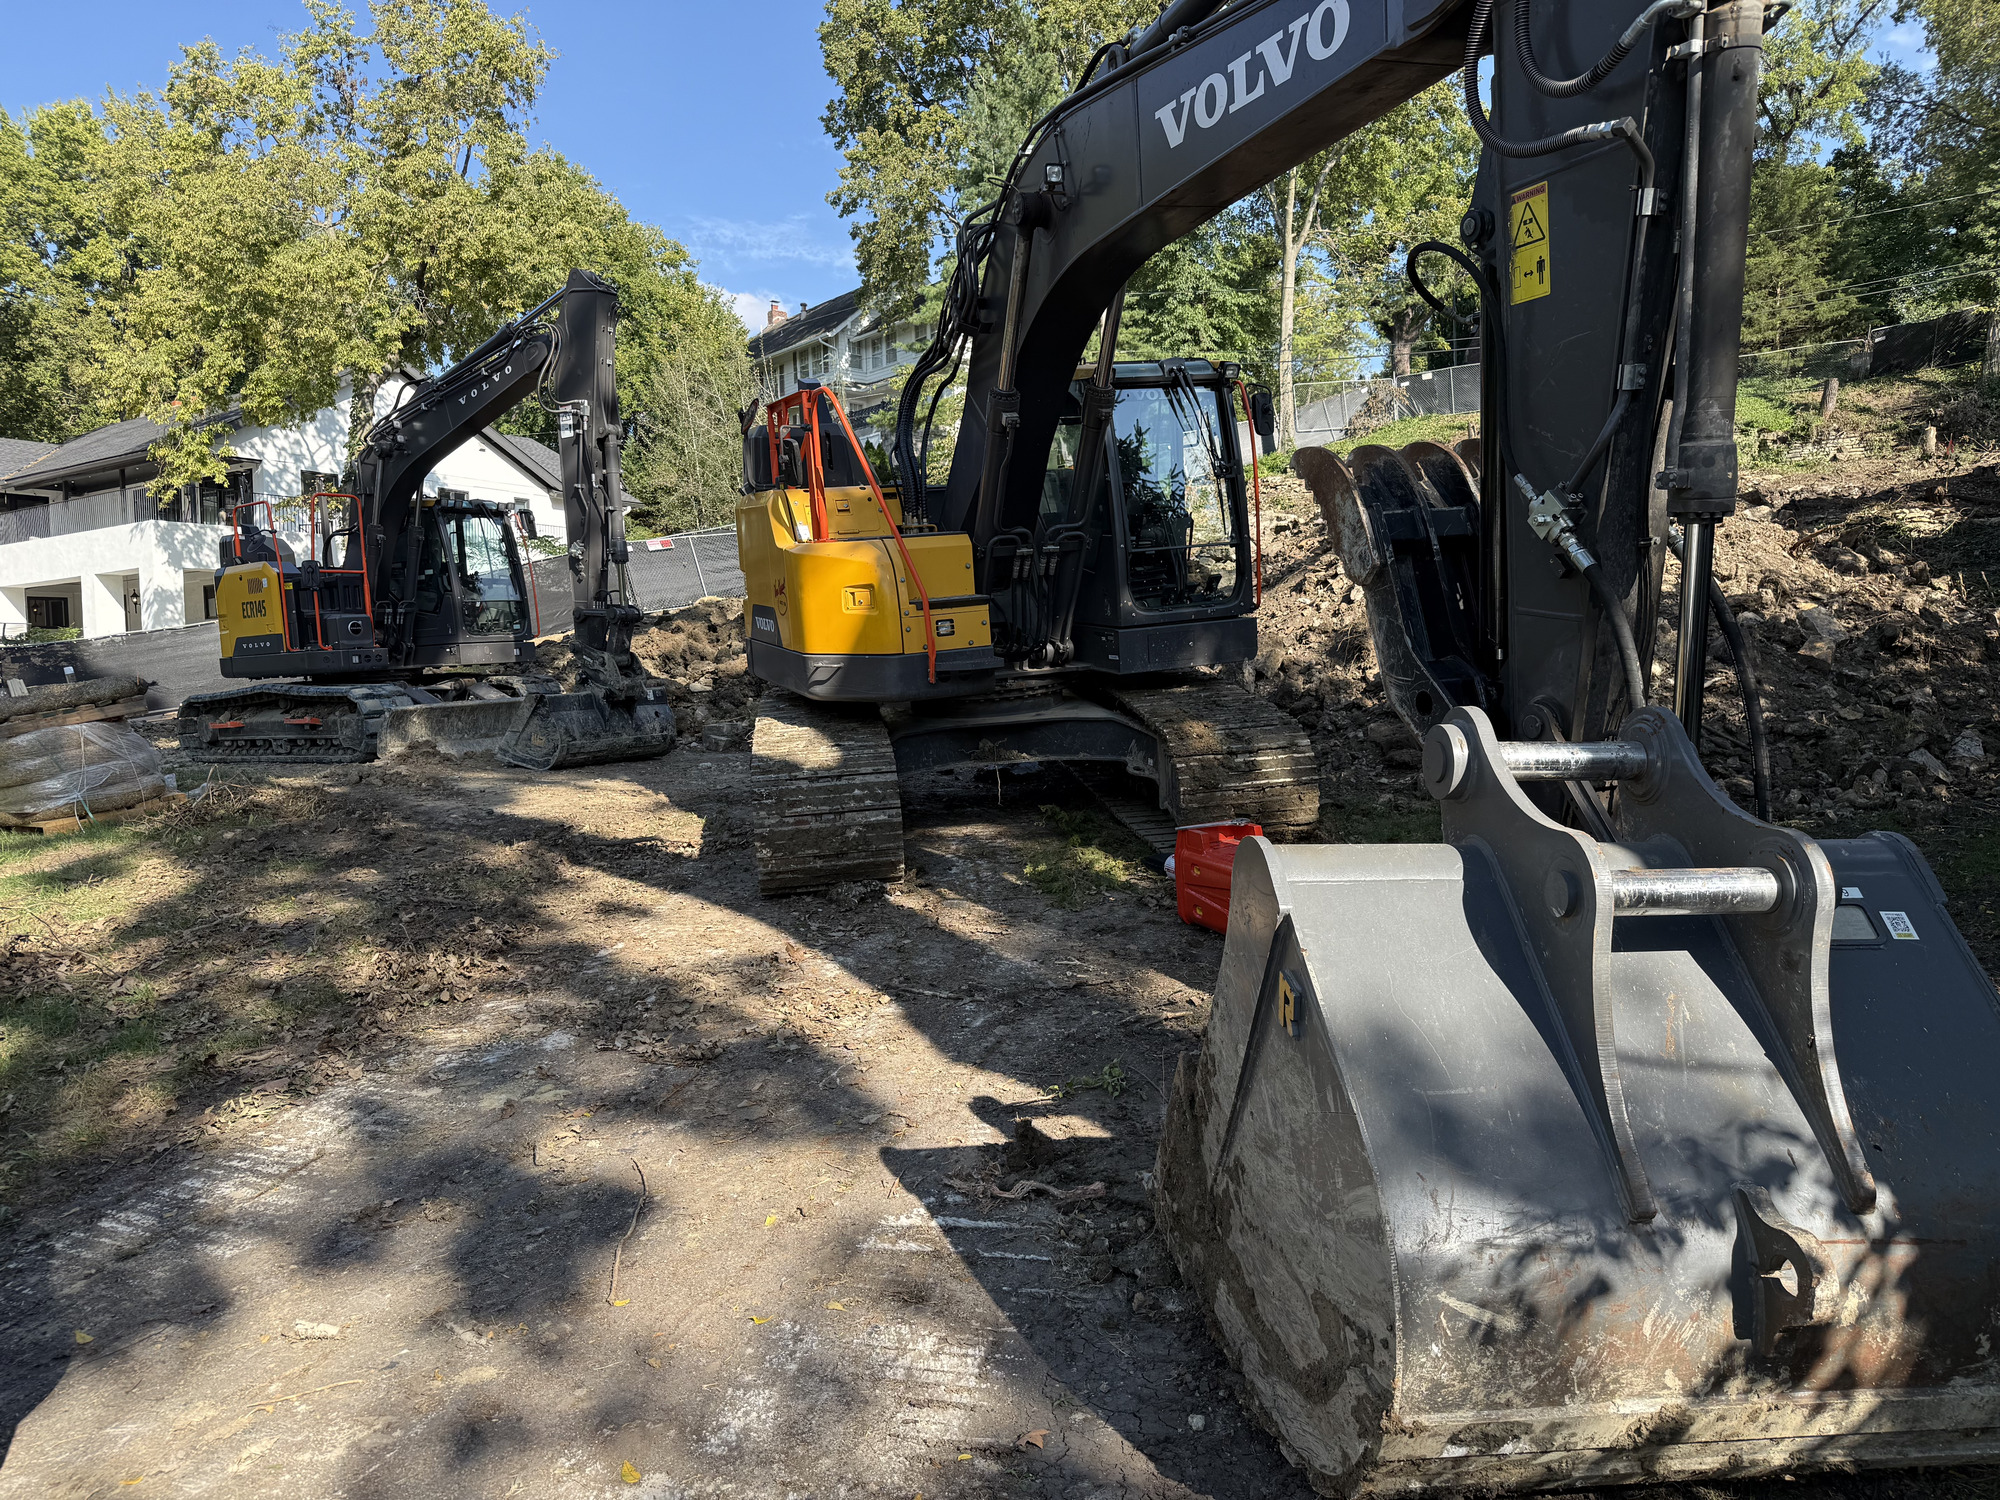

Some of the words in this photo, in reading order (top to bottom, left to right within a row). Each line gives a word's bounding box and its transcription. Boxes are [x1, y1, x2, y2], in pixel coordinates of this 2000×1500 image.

[1154, 0, 1350, 149] VOLVO
[1516, 185, 1545, 202] WARNING
[458, 365, 512, 405] VOLVO
[242, 600, 267, 619] ECR145
[755, 616, 775, 633] VOLVO
[242, 641, 271, 649] VOLVO
